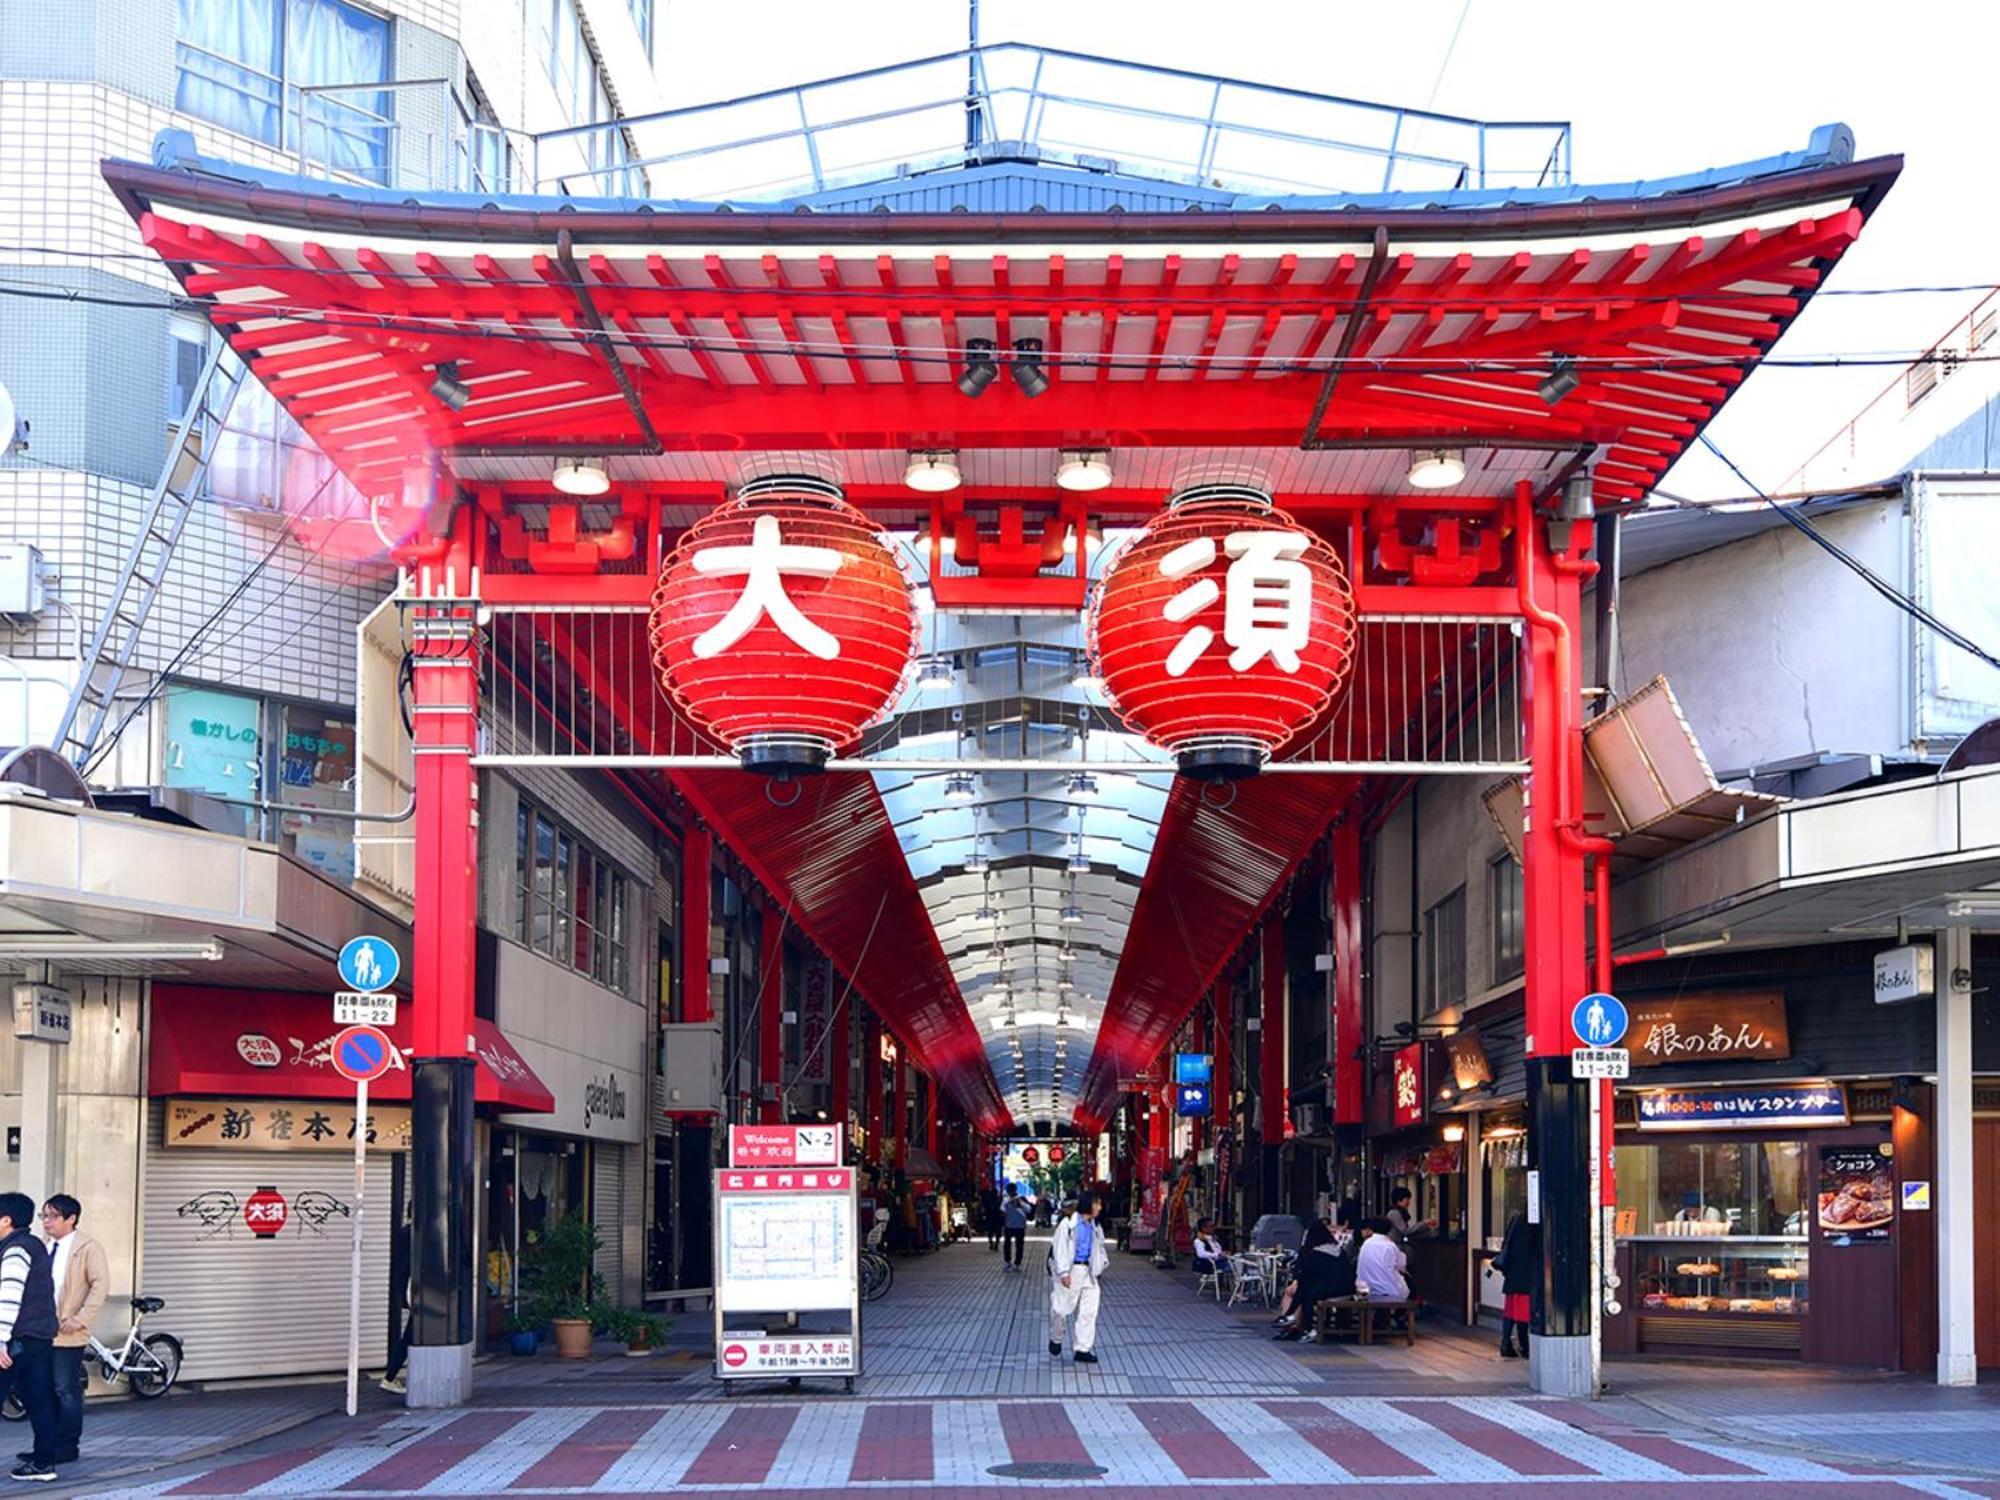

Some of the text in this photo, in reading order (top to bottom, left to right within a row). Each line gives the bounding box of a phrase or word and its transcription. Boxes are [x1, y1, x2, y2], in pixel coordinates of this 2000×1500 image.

[692, 515, 843, 661] 大
[1158, 530, 1312, 677] 須
[341, 1009, 389, 1022] 11-22
[1643, 1022, 1764, 1057] 銀のあん
[1579, 1064, 1623, 1076] 11-22
[220, 1107, 379, 1145] 新雀本店
[744, 1133, 790, 1145] Welcome
[248, 1202, 285, 1221] 大須
[758, 1342, 850, 1355] 車両進入禁止
